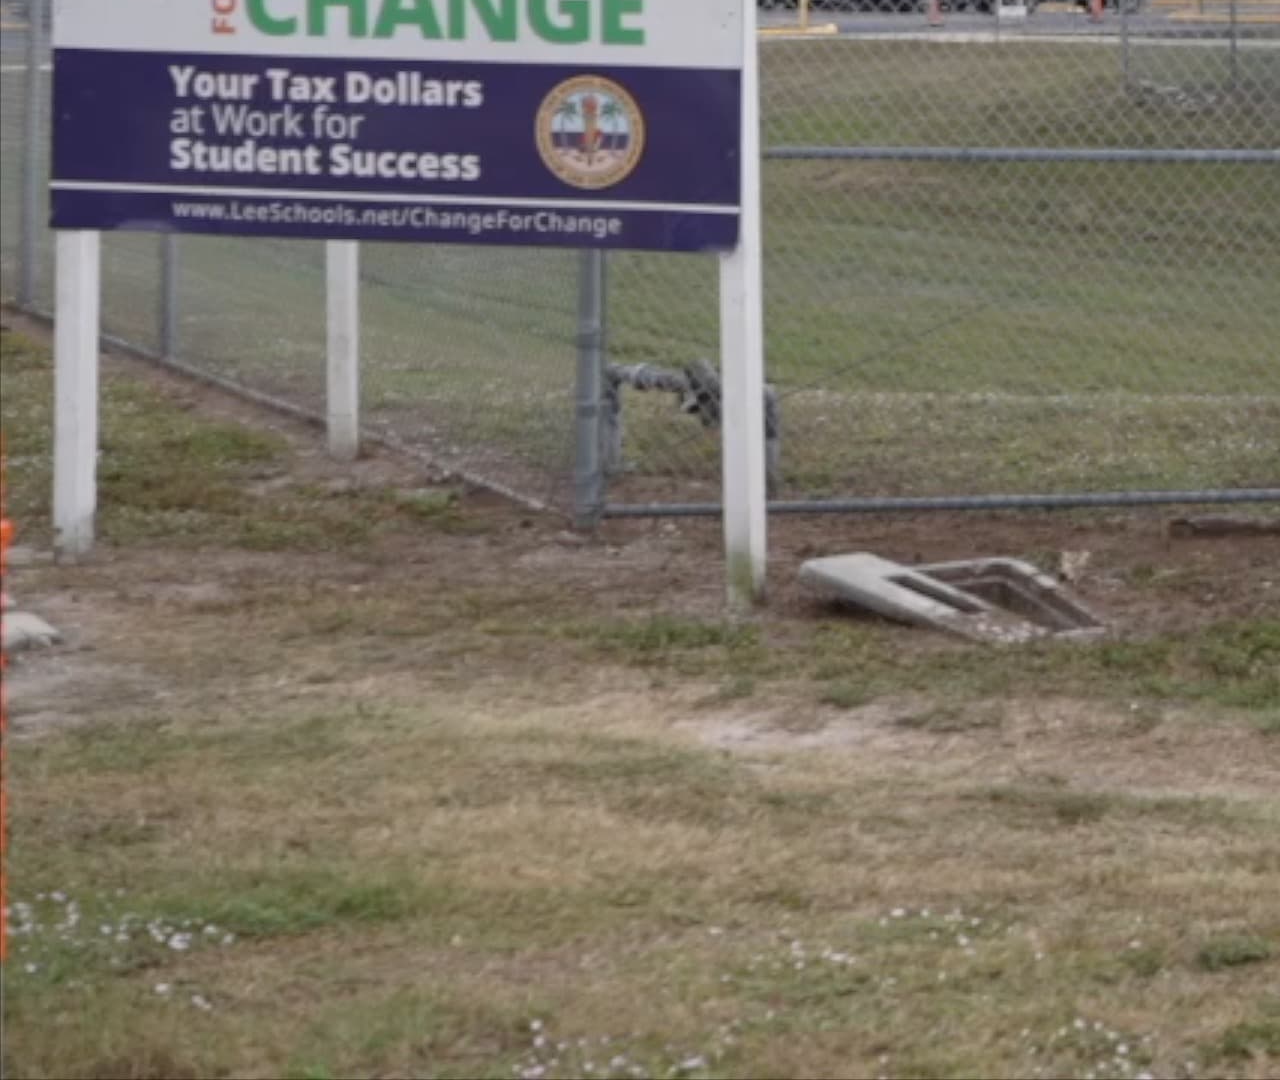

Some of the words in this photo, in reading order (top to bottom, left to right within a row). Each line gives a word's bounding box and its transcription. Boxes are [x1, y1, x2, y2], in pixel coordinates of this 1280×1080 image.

[168, 65, 259, 100] Your
[266, 69, 337, 102] Tax
[346, 71, 483, 107] Dollars
[169, 107, 205, 134] at
[211, 104, 304, 138] Work
[312, 105, 365, 140] for
[169, 138, 321, 176] Student
[329, 143, 481, 181] Success
[171, 200, 622, 237] www.LeeSchools.net/ChangeForChange
